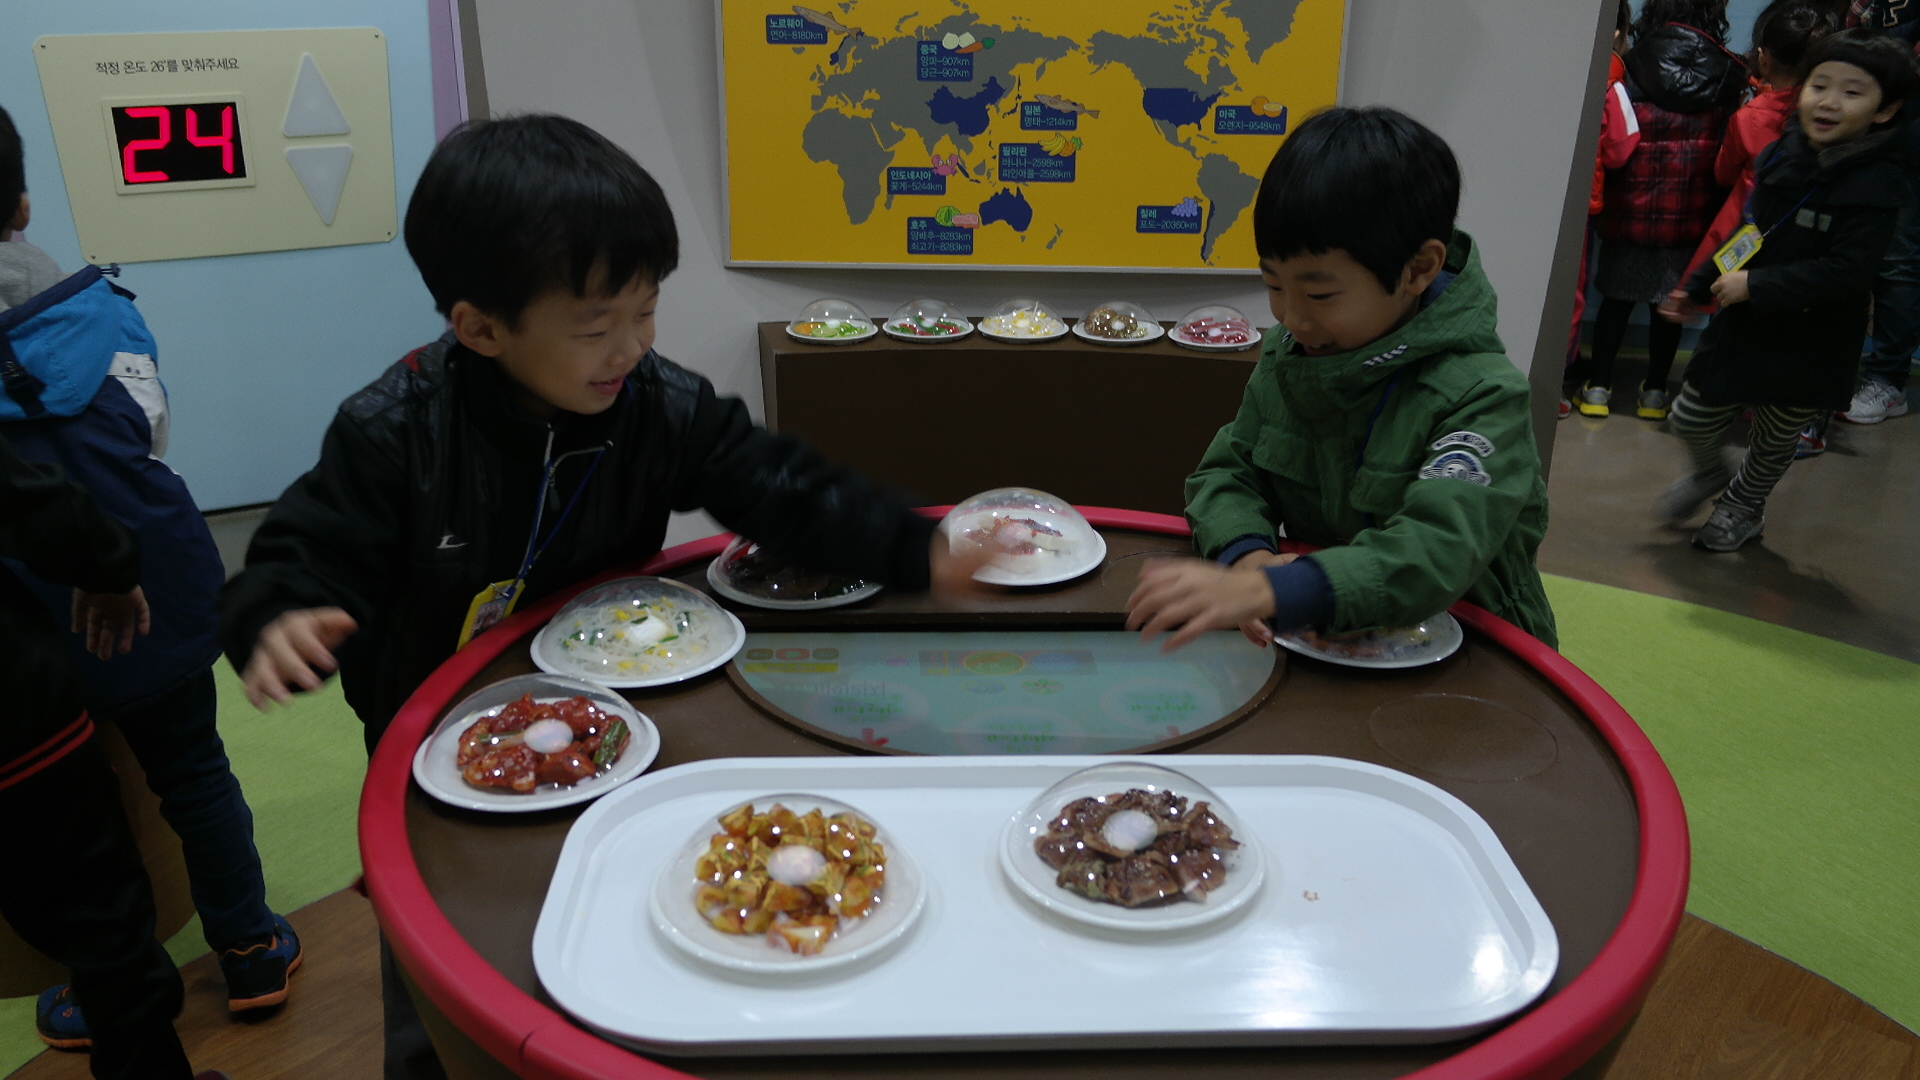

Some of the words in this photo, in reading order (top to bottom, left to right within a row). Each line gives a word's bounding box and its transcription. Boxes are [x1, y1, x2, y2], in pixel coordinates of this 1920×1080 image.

[769, 18, 804, 29] 노르웨이
[920, 44, 938, 56] 중국
[95, 61, 120, 76] 적정
[123, 60, 148, 75] 온도
[181, 57, 240, 72] 맞춰주세요
[1024, 105, 1041, 116] 일본
[1218, 108, 1236, 120] 미국
[123, 105, 234, 183] 24
[1002, 146, 1027, 157] 필리핀
[890, 170, 931, 181] 인도네시아
[1140, 208, 1157, 219] 칠레
[910, 220, 928, 230] 호주
